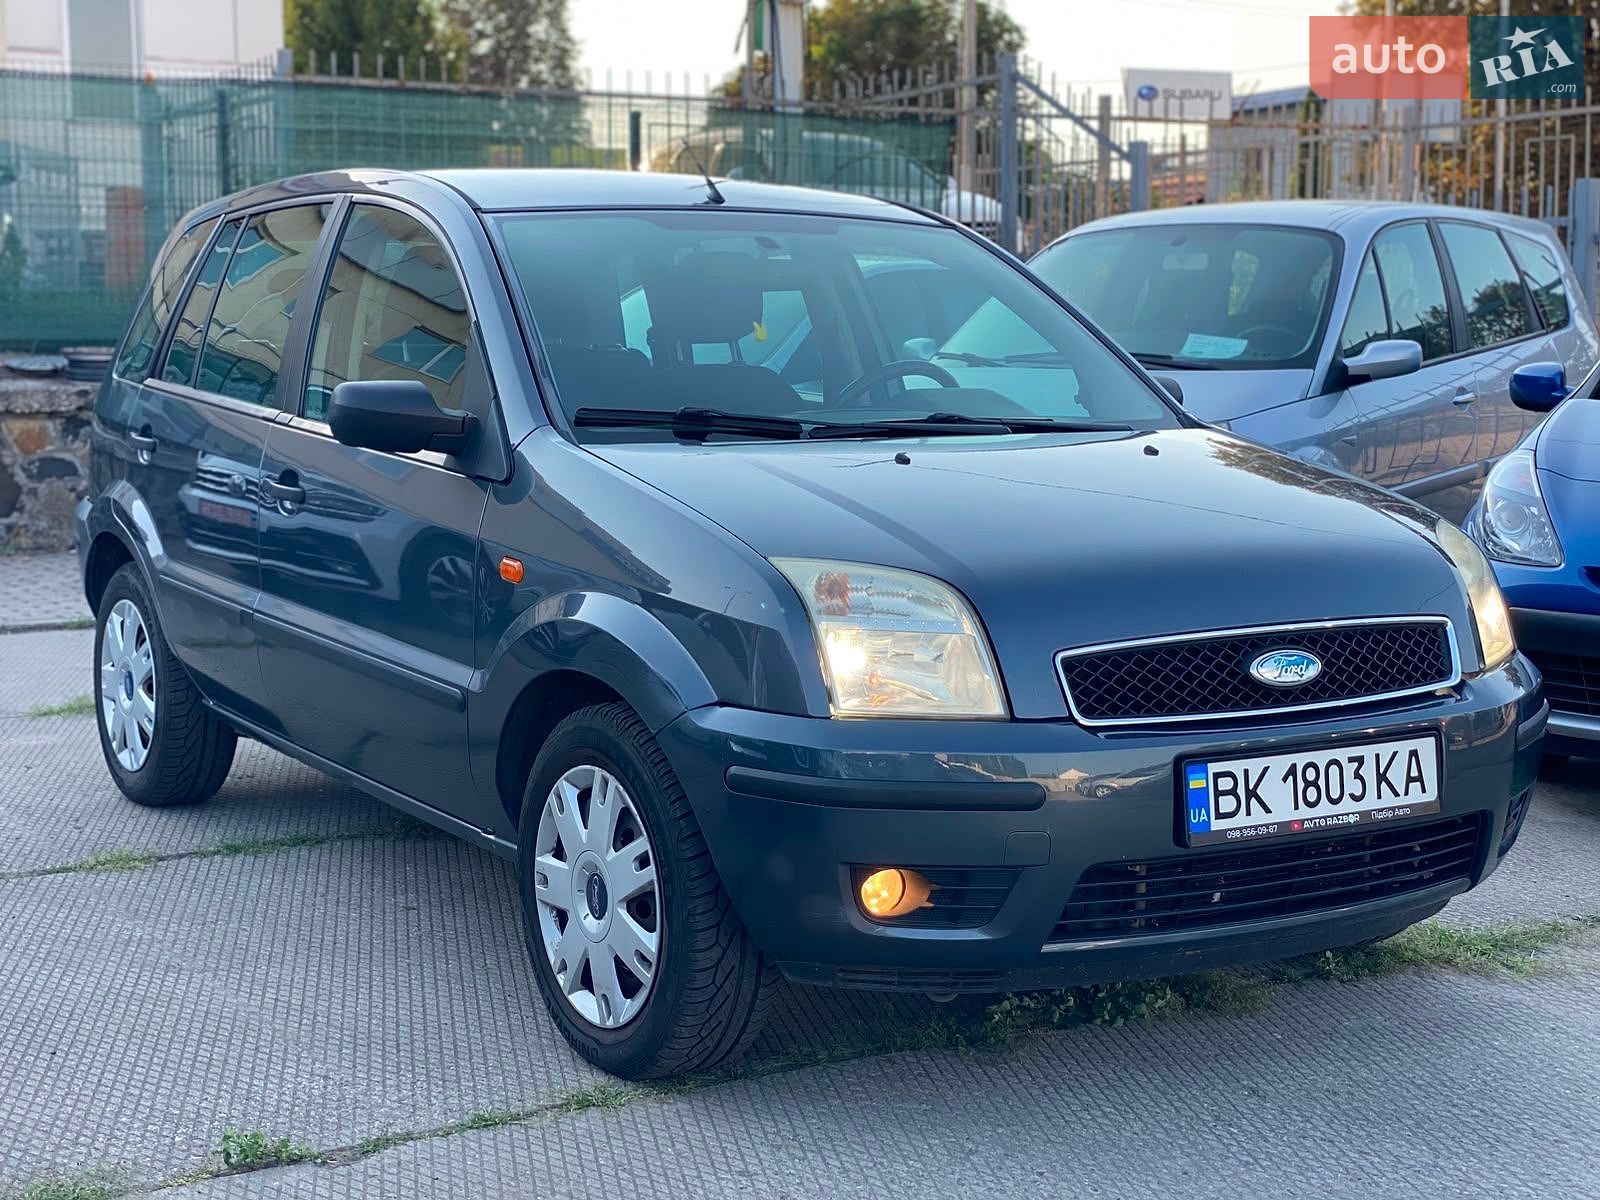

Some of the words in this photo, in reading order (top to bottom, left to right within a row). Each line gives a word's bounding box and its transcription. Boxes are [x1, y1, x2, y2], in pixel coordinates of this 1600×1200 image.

[1212, 765, 1273, 820] BK
[1281, 754, 1367, 810] 1803
[1375, 748, 1427, 800] KA
[1190, 807, 1209, 823] UA
[1371, 808, 1394, 820] Підбір
[1394, 807, 1411, 816] Авто
[1226, 824, 1278, 839] 098-956-09-87
[1303, 819, 1326, 829] AVTO
